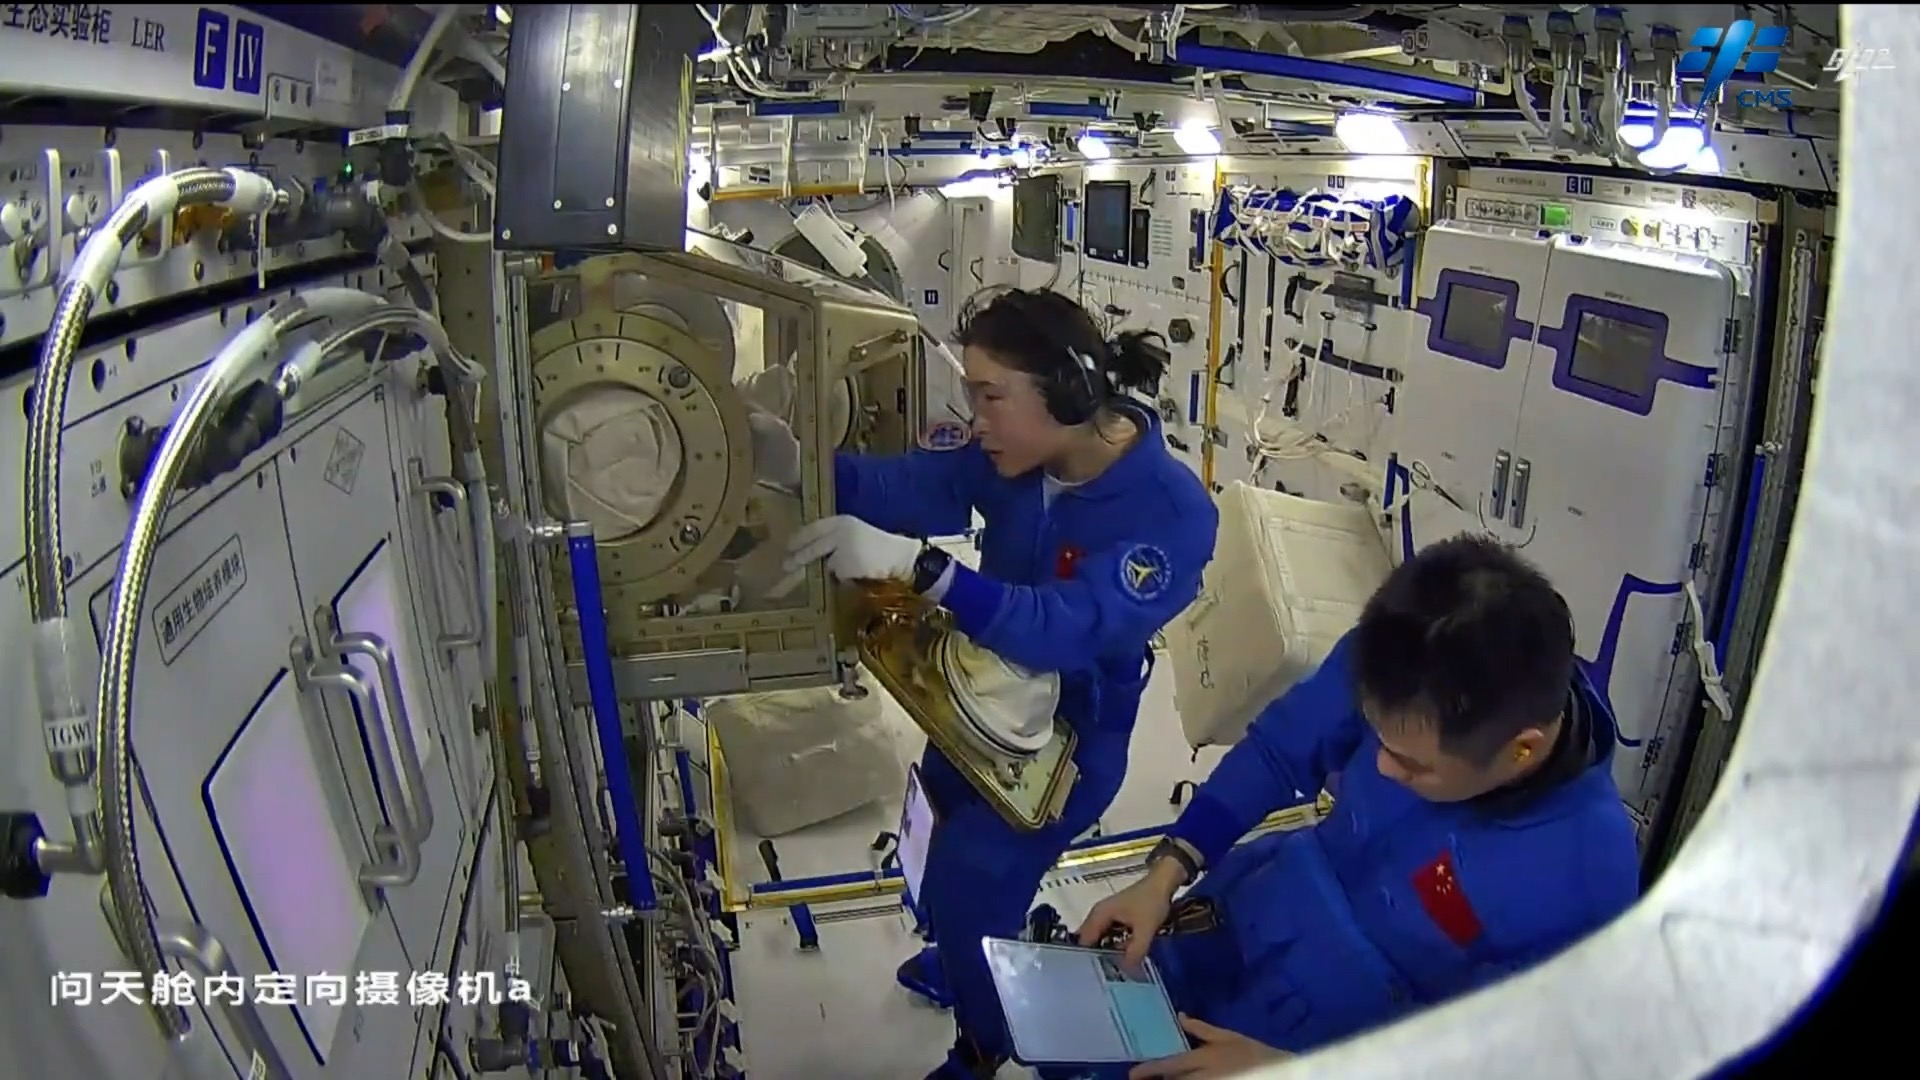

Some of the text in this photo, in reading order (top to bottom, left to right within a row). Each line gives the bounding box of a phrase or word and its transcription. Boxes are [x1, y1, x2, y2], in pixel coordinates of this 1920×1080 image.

[131, 17, 164, 51] LER
[202, 20, 260, 80] F IV
[161, 552, 241, 648] 通用生物培养模块
